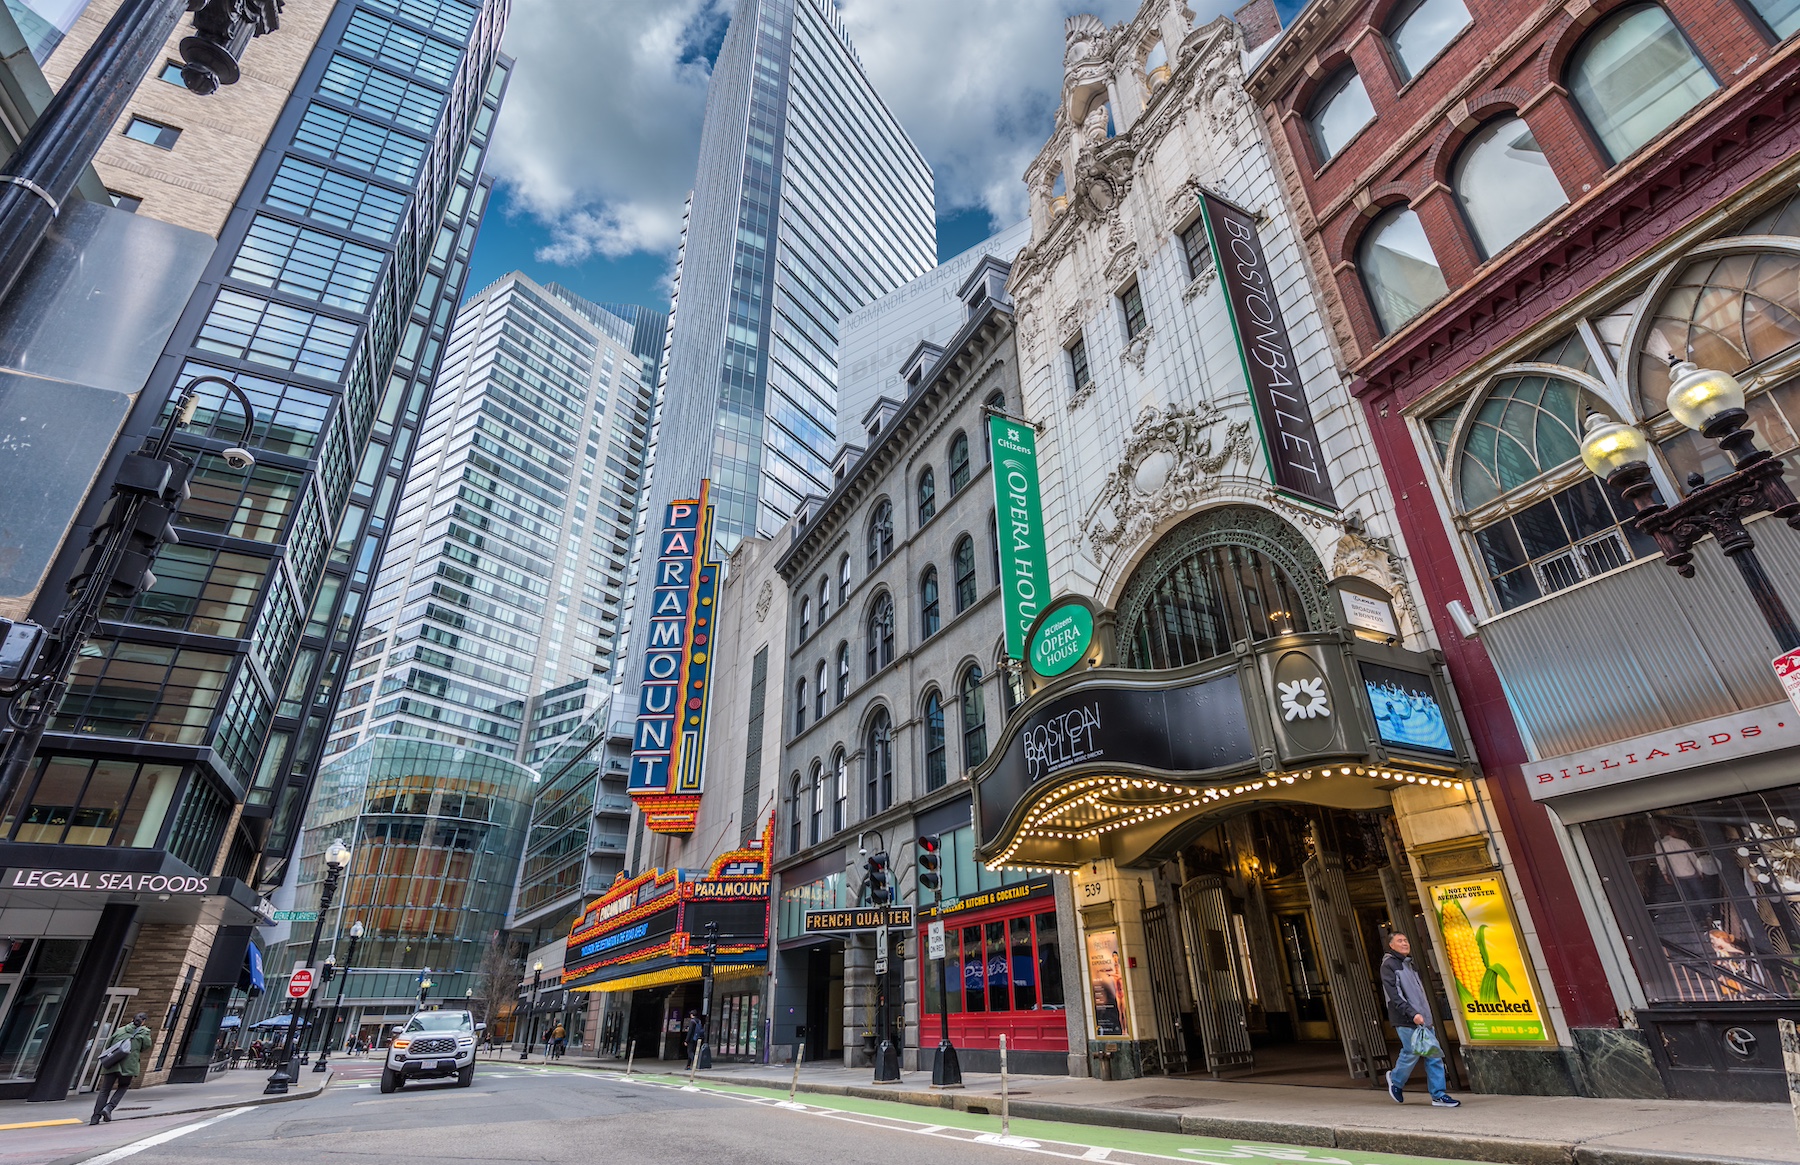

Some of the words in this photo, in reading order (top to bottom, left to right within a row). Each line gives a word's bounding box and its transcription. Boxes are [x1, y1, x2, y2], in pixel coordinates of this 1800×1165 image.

[846, 292, 907, 332] NORMANDIE
[909, 256, 971, 298] BALLROOM
[975, 237, 1002, 262] 1935
[852, 322, 936, 381] BIJOU
[998, 438, 1032, 455] Citizens
[1007, 471, 1031, 553] OPERA
[1015, 558, 1038, 648] HOUS
[1351, 604, 1382, 617] BROADWAY
[1050, 616, 1073, 634] Citizens
[1358, 612, 1384, 623] BOSTON
[639, 505, 692, 785] PARAMOUNT
[1041, 624, 1081, 656] OPERA
[1046, 640, 1079, 667] HOUSE
[1023, 701, 1101, 759] BOSTON
[1027, 720, 1095, 781] BALLET
[1087, 749, 1104, 759] DIRECTOR
[1536, 725, 1763, 785] BILLIARDS
[12, 870, 91, 889] LEGAL
[96, 873, 134, 891] SEA
[136, 874, 210, 893] FOODS
[695, 881, 769, 897] PARAMOUNT
[1085, 882, 1101, 898] 539
[1448, 887, 1462, 895] NOT
[1463, 885, 1482, 893] YOUR
[966, 894, 989, 909] KITCHEN
[990, 893, 995, 903] &
[996, 885, 1030, 902] COCKTAILS
[1437, 892, 1468, 902] AVERAGE
[806, 913, 852, 929] FRENCH
[856, 910, 910, 926] QUATER
[931, 935, 942, 943] TURN
[933, 926, 939, 935] NO
[930, 946, 936, 954] ON
[936, 944, 944, 952] RED
[1091, 959, 1112, 967] EXPERIENCE
[1466, 999, 1533, 1014] shucked
[1491, 1025, 1517, 1034] APRIL
